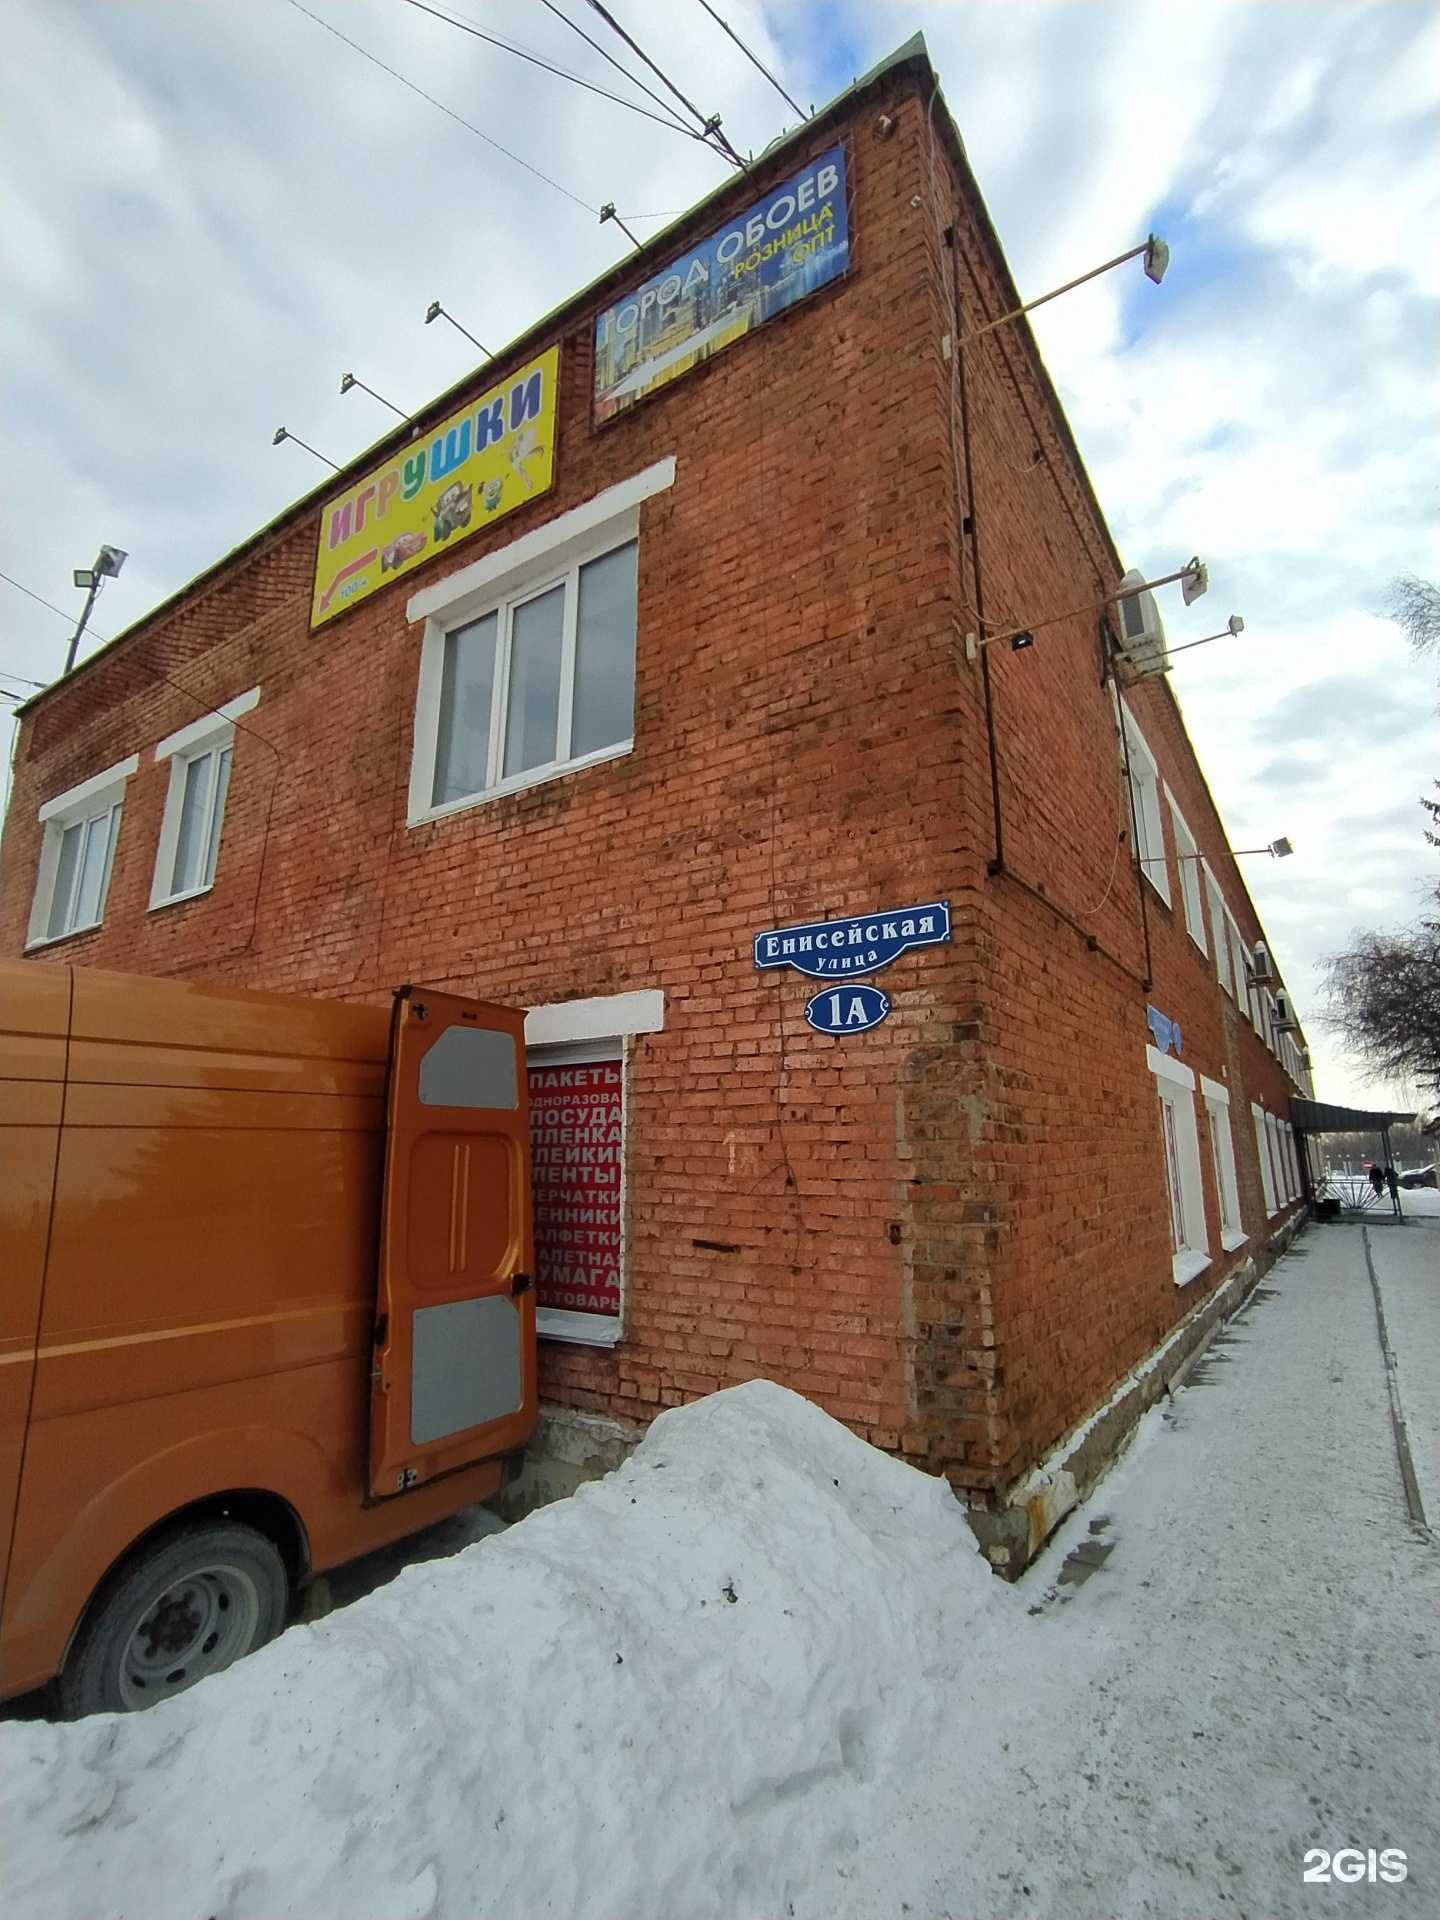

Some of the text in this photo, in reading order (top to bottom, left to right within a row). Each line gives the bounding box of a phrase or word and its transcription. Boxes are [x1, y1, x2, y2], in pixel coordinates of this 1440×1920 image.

[716, 164, 838, 264] ОБОЕВ
[734, 206, 834, 280] РОЗНИЦА
[792, 227, 835, 263] ОПТ
[328, 368, 543, 549] ИГРУШКИ
[766, 915, 935, 957] Енисейская
[816, 950, 878, 971] улица
[828, 994, 869, 1026] 1А
[530, 1106, 621, 1126] ПОСУДА
[530, 1126, 621, 1144] ПЛЕНКА
[531, 1144, 622, 1163] ЛЕЙКИ
[533, 1167, 615, 1183] ЛЕНТЫ
[534, 1189, 620, 1204] ЕРЧАТКИ
[536, 1208, 620, 1224] ЕННИКИ
[535, 1229, 620, 1246] АЛФЕТКИ
[538, 1249, 620, 1267] АЛЕТНА
[539, 1264, 619, 1288] УМАГА
